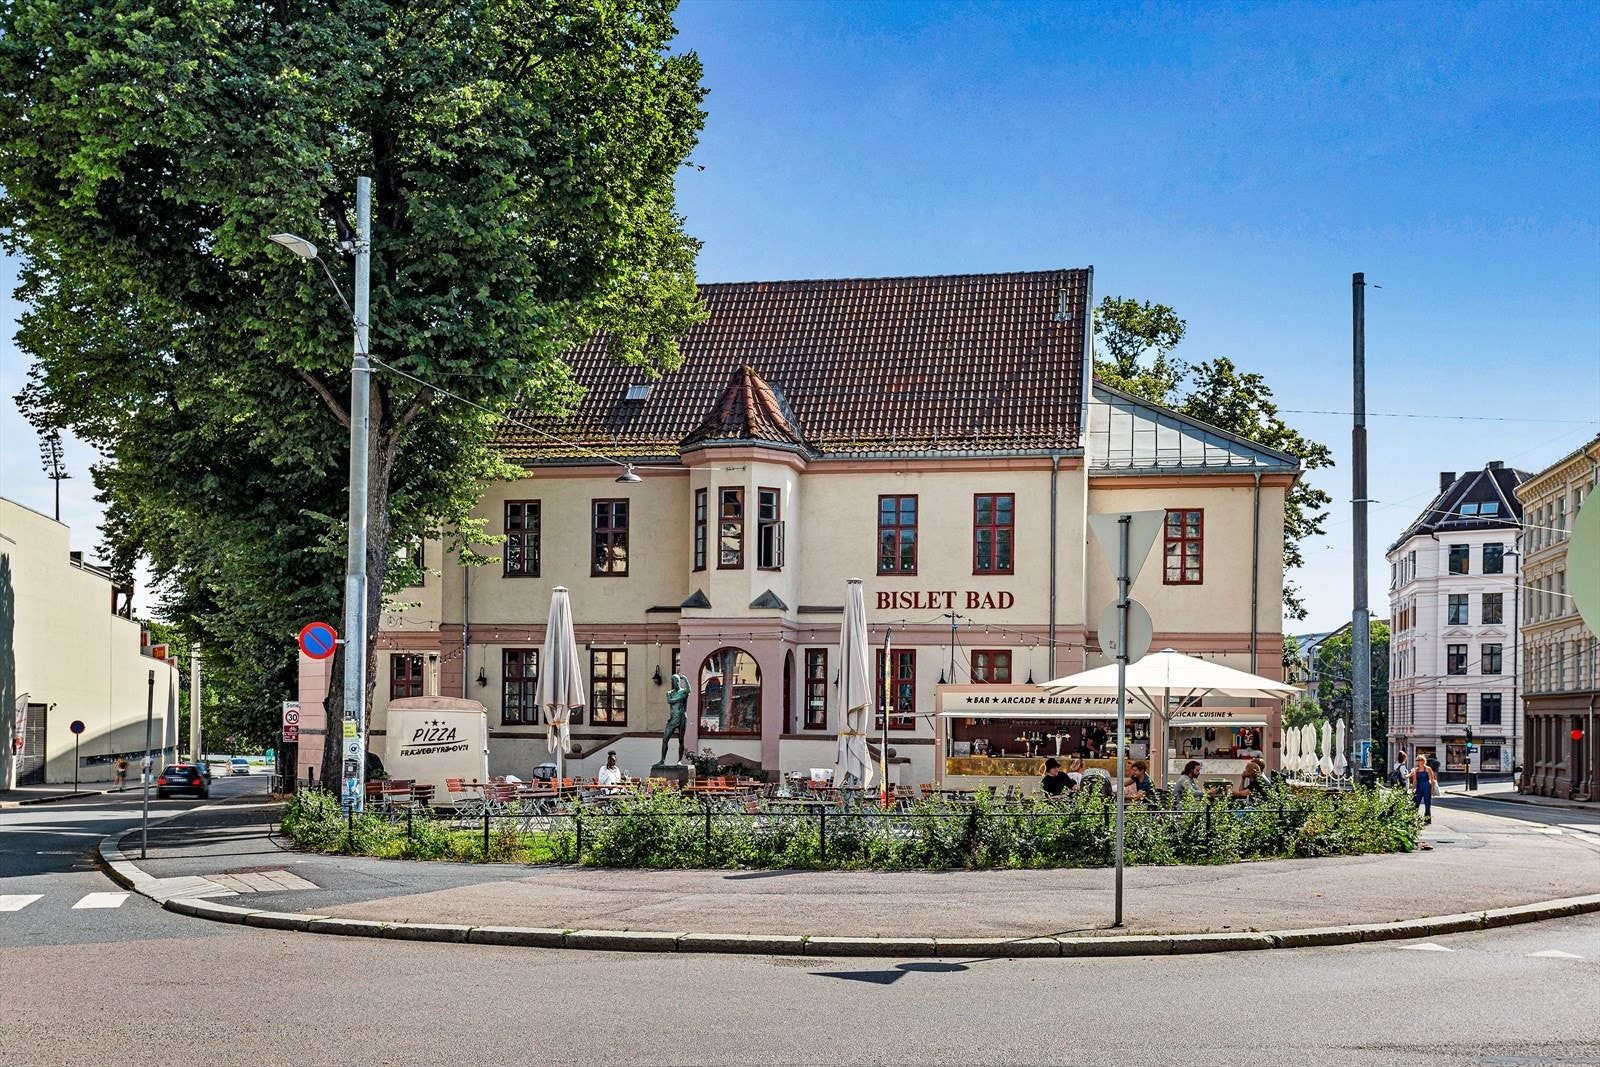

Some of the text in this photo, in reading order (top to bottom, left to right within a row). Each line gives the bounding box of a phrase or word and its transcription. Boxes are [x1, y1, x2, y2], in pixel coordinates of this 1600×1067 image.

[876, 591, 1015, 610] BISLET BAD
[973, 696, 1119, 705] BAR ARCADE BILBANE FLIPPE
[288, 713, 298, 722] 30
[412, 727, 457, 742] PIZZA
[400, 749, 415, 757] FRA
